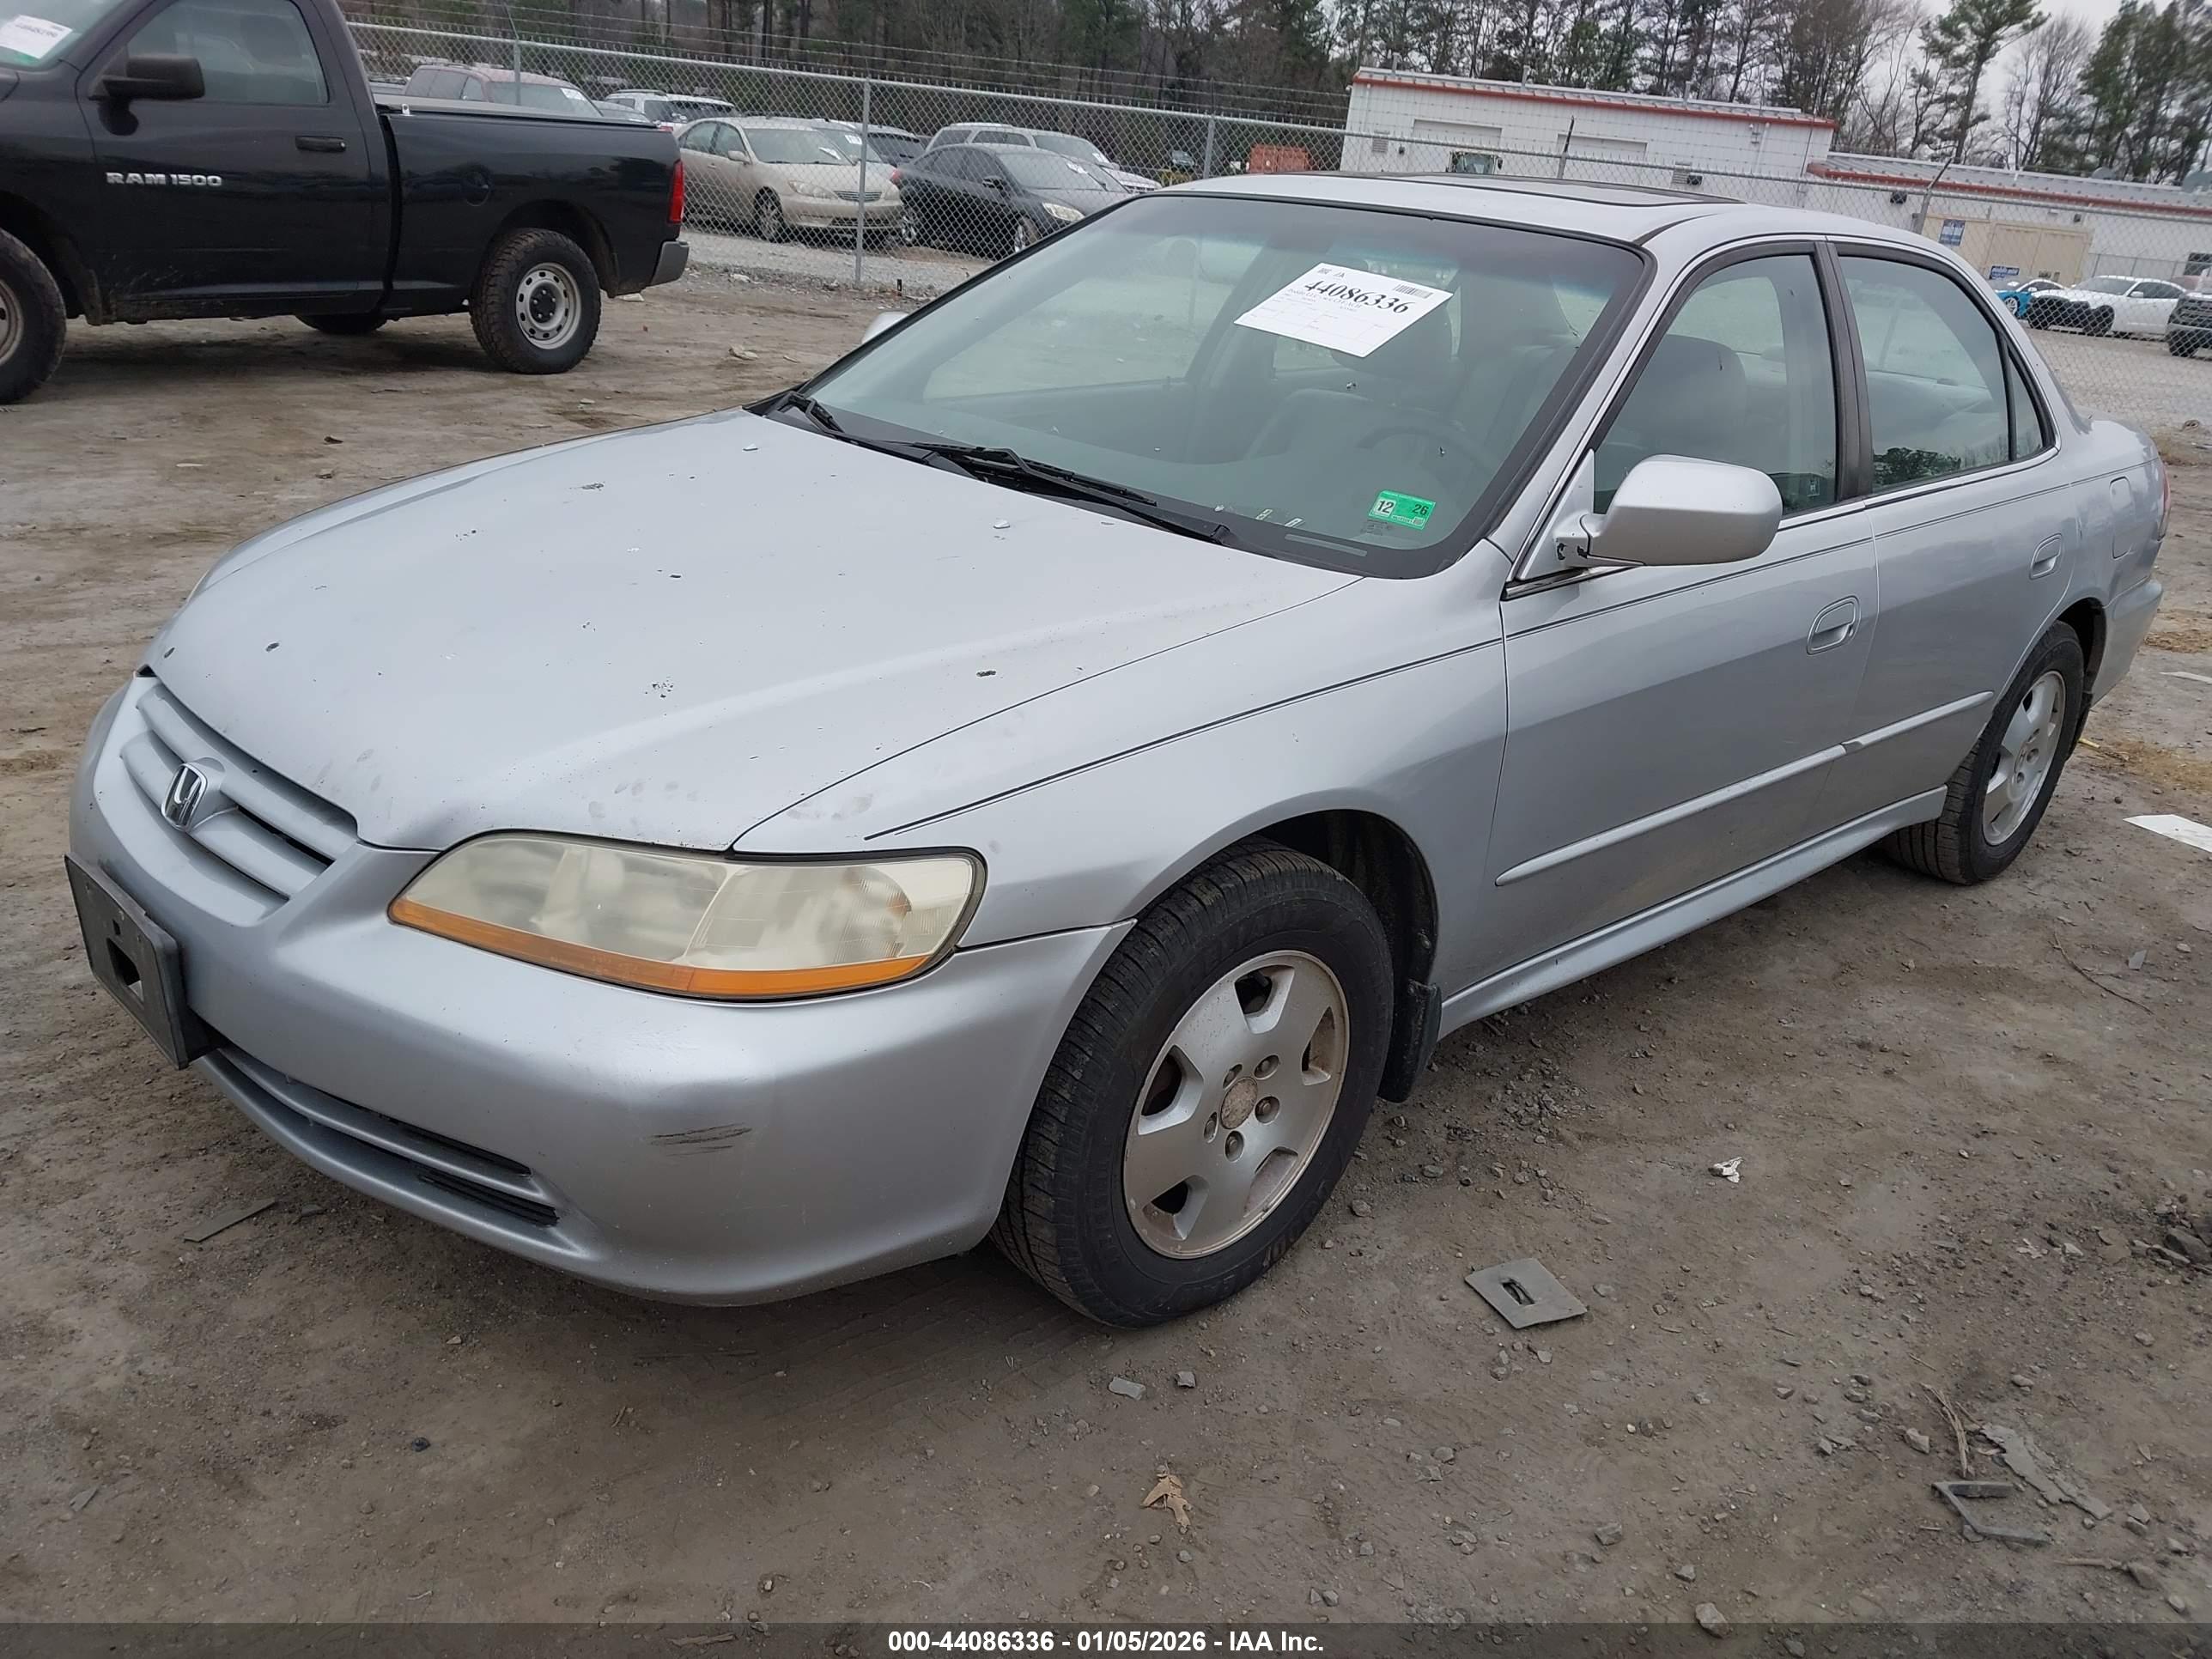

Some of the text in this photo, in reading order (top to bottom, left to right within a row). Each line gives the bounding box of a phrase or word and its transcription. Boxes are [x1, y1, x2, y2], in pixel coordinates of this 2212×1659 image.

[106, 172, 222, 186] RAM 1500
[1304, 280, 1416, 313] 44086336
[1377, 500, 1394, 514] 12
[1412, 503, 1429, 515] 26
